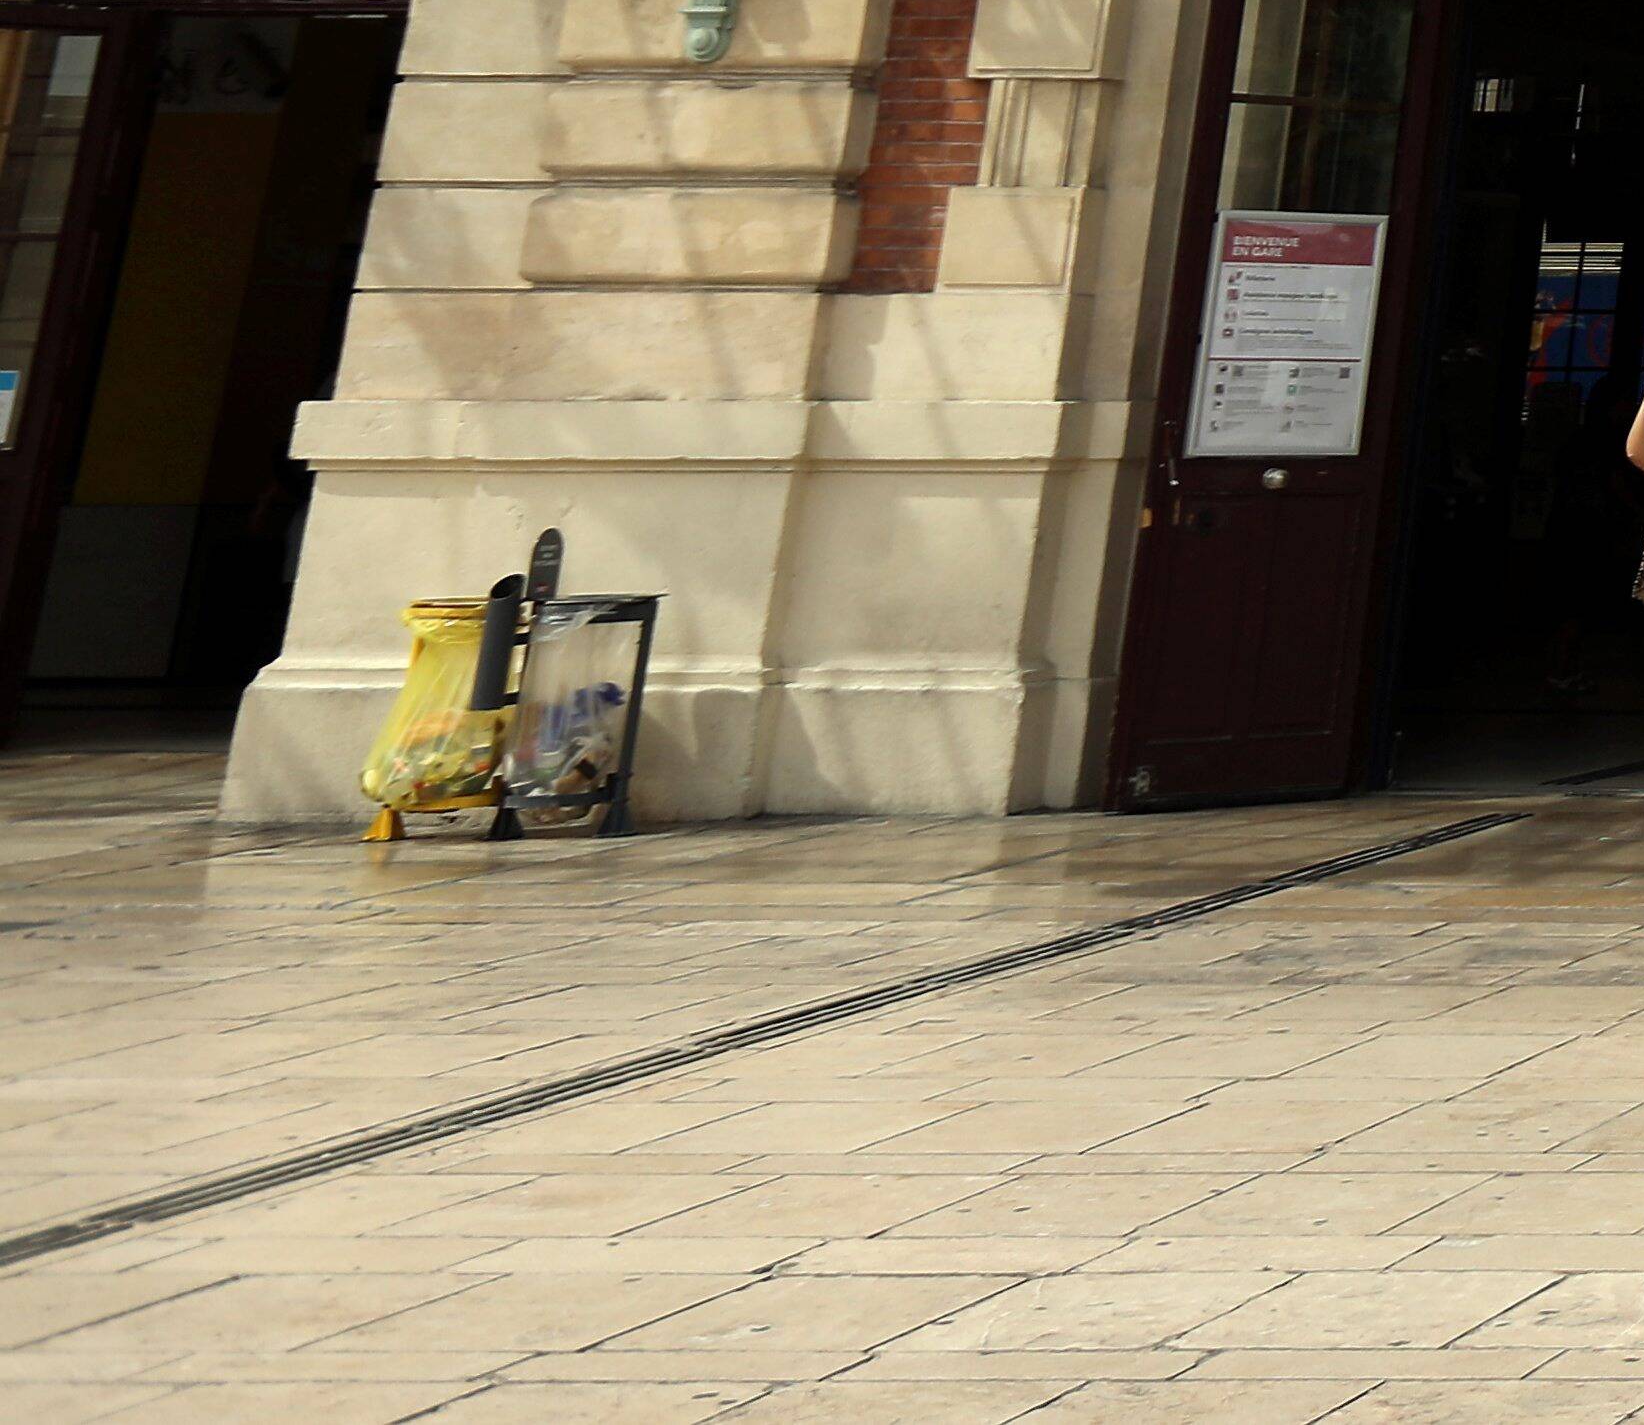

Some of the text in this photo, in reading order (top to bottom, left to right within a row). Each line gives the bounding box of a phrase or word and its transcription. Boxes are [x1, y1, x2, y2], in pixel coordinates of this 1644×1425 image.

[1232, 235, 1300, 247] BIENVENUE
[1232, 246, 1284, 257] EN GARE
